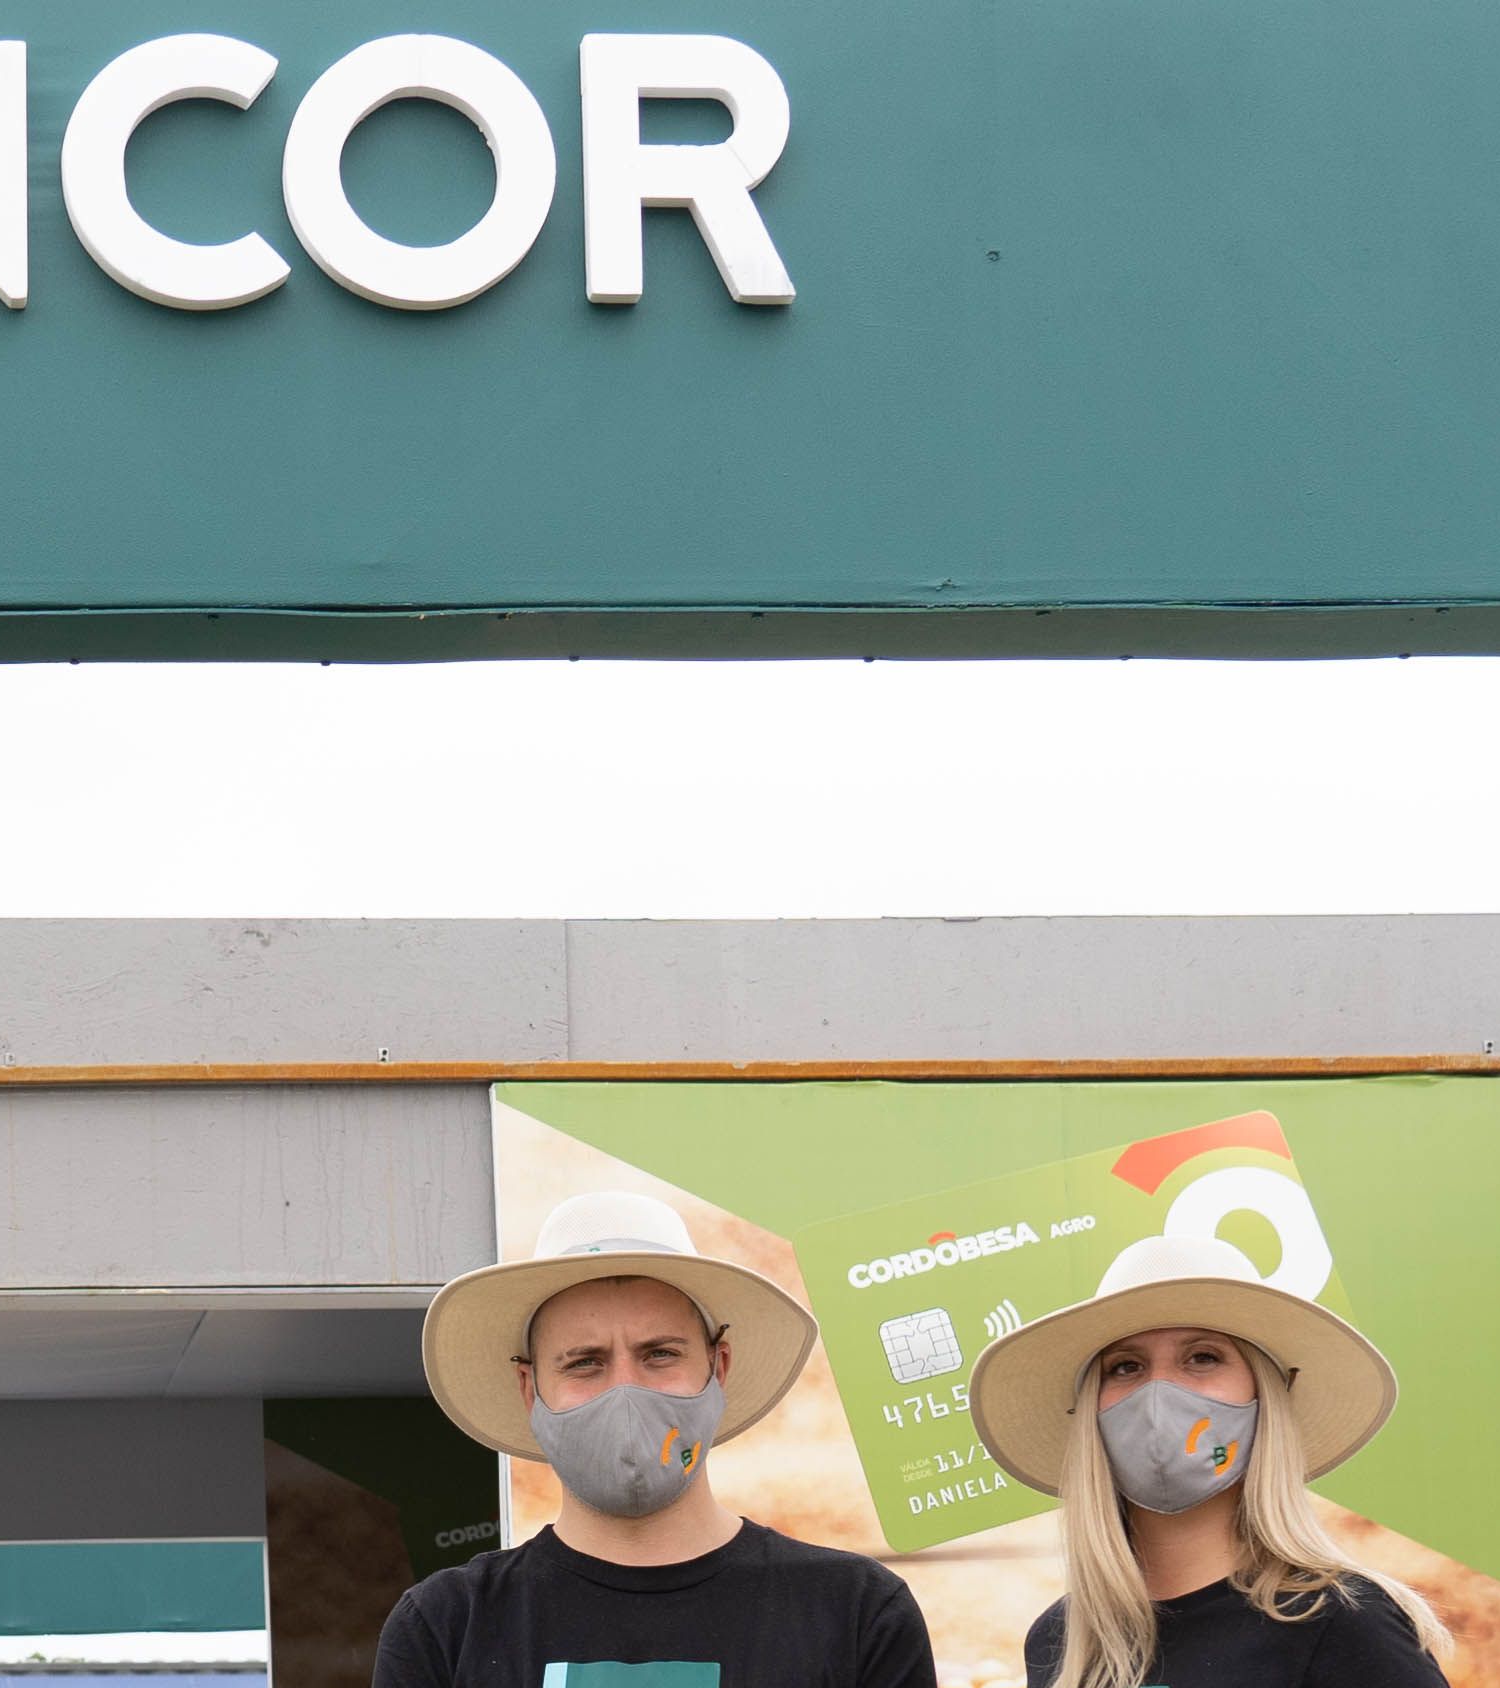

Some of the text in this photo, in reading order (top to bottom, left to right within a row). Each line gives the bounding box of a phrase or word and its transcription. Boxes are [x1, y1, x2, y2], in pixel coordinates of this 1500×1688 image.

[1050, 1215, 1097, 1239] AGRO
[882, 1384, 969, 1428] 4765
[909, 1472, 1007, 1514] DANIELA
[435, 1520, 499, 1548] CORD
